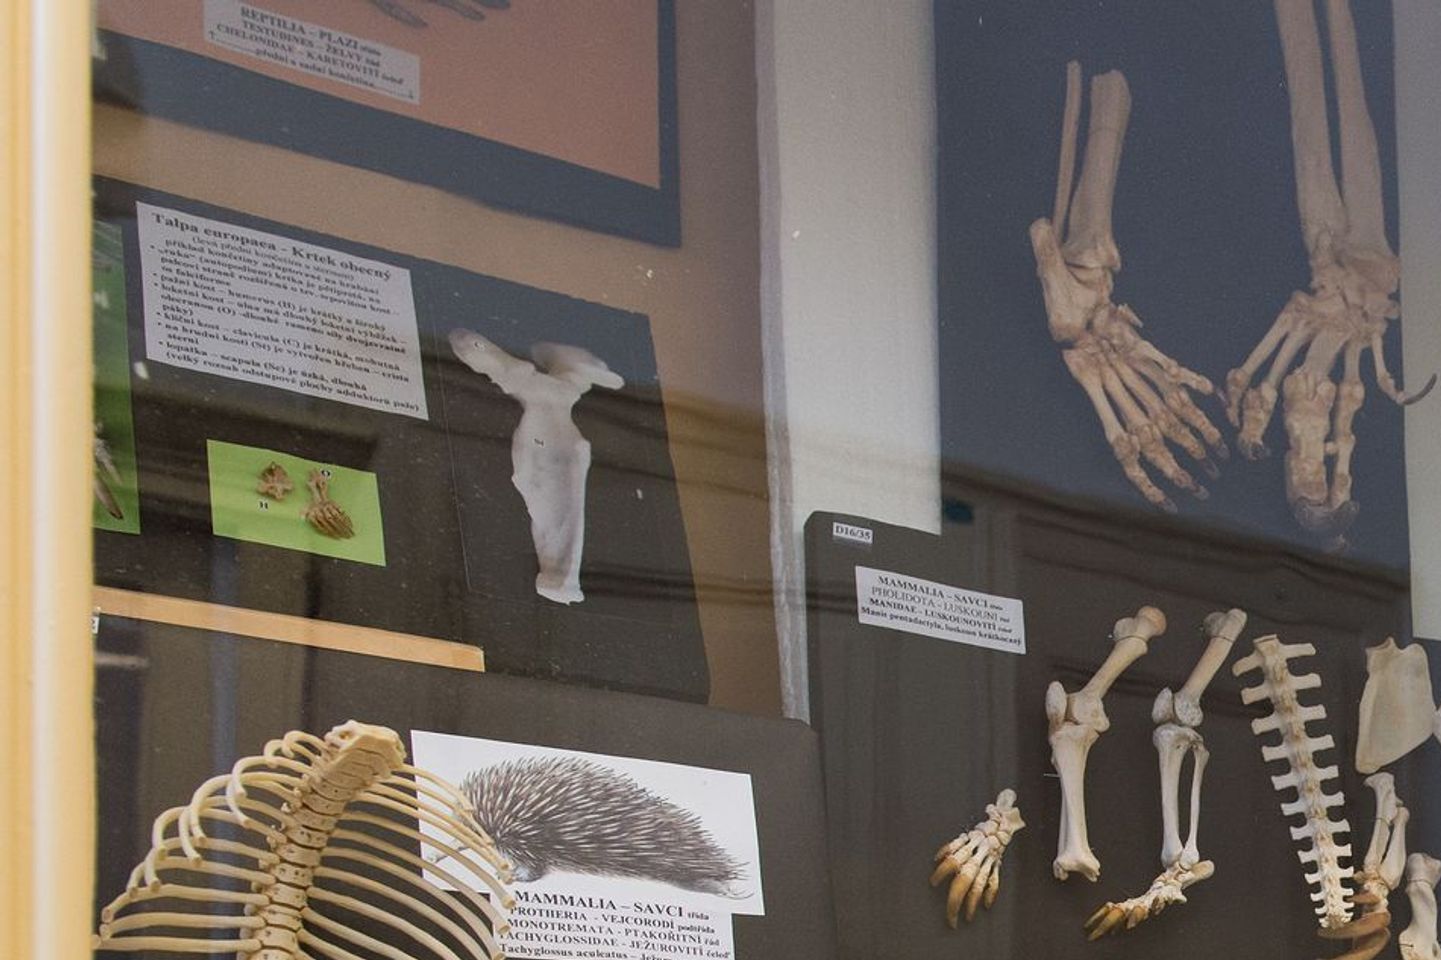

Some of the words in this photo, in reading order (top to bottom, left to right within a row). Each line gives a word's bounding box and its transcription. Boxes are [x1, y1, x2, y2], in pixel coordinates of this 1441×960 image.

[240, 7, 305, 34] REPTILIA
[318, 30, 356, 49] PLAZI
[151, 212, 198, 234] Talpa
[203, 227, 276, 252] europaea
[292, 246, 336, 265] Krtek
[339, 259, 391, 281] obecný
[835, 525, 871, 541] D16/35
[871, 586, 934, 607] PHOLIDOTA
[943, 602, 997, 620] LUSKOUNI
[878, 576, 943, 597] MAMMALIA
[954, 593, 987, 607] SAVCI
[869, 597, 915, 613] MANIDAE
[515, 888, 616, 912] MAMMALIA
[634, 902, 682, 917] SAVCI
[510, 905, 586, 921] PROTHERIA
[601, 913, 674, 929] VEJCORODÍ
[507, 918, 613, 936] MONOTREMATA
[625, 927, 701, 943] PTAKOŘITNÍ
[499, 943, 572, 958] Tachyglossus
[576, 948, 627, 960] aculeatus
[630, 938, 702, 955] JEŽUROVITÍ
